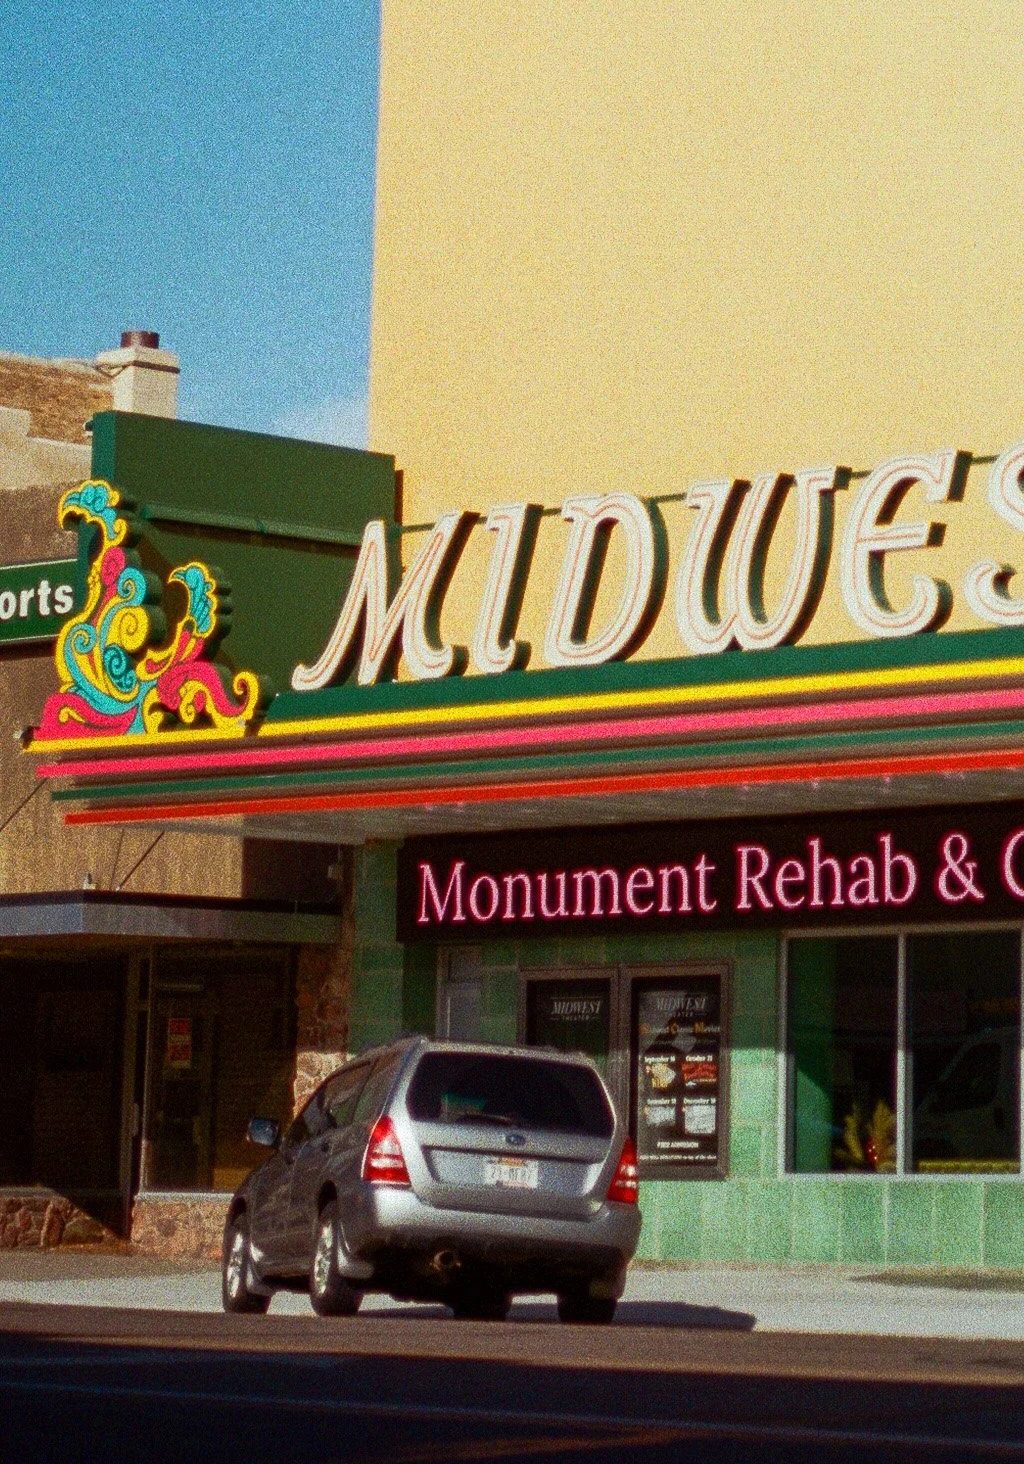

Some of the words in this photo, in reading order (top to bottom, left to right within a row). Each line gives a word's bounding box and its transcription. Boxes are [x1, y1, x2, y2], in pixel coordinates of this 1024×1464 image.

[0, 579, 73, 620] orts
[417, 854, 718, 924] Monument
[736, 834, 917, 910] Rehab
[937, 833, 985, 902] &
[551, 1000, 601, 1014] MIDWEST
[655, 996, 706, 1011] MIDWEST
